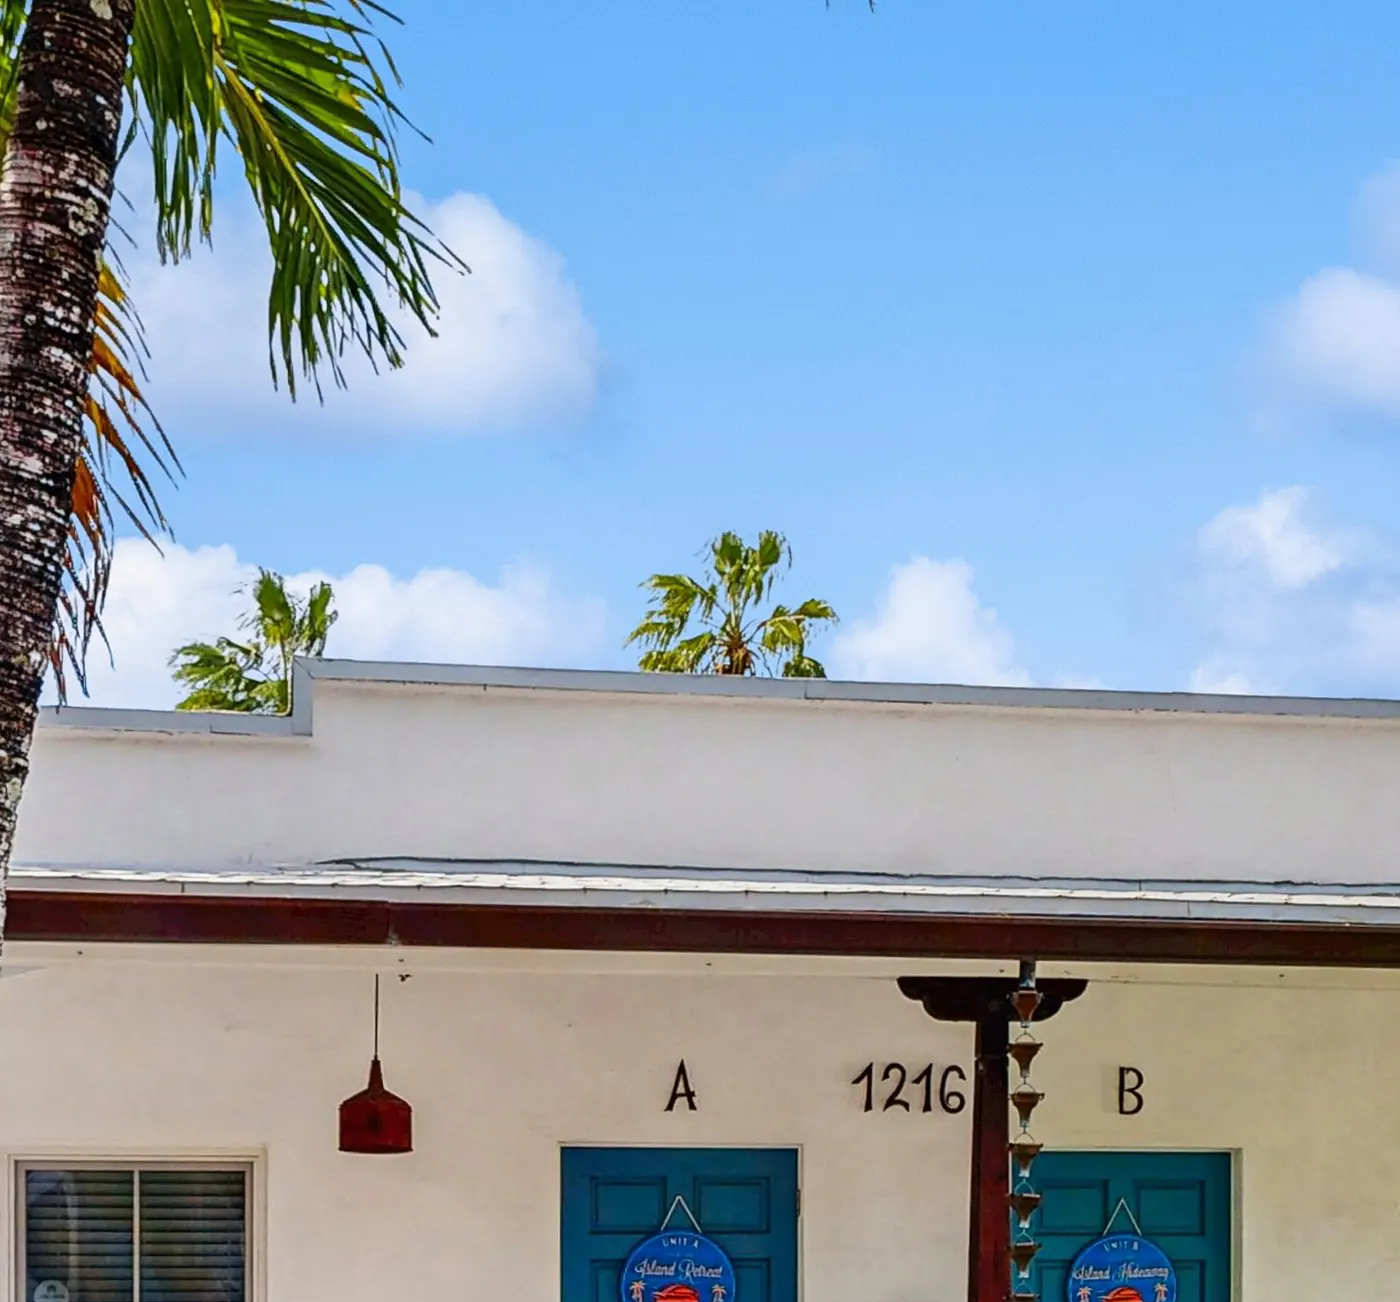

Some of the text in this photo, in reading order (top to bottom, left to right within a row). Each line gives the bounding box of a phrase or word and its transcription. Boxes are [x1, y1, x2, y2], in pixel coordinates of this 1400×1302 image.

[665, 1059, 698, 1112] A
[852, 1062, 967, 1113] 1216
[1118, 1066, 1145, 1115] B
[662, 1237, 688, 1247] UNIT
[1103, 1240, 1128, 1251] UNIT
[634, 1258, 723, 1284] Island Retreat
[1073, 1261, 1169, 1284] Island Hideaway
